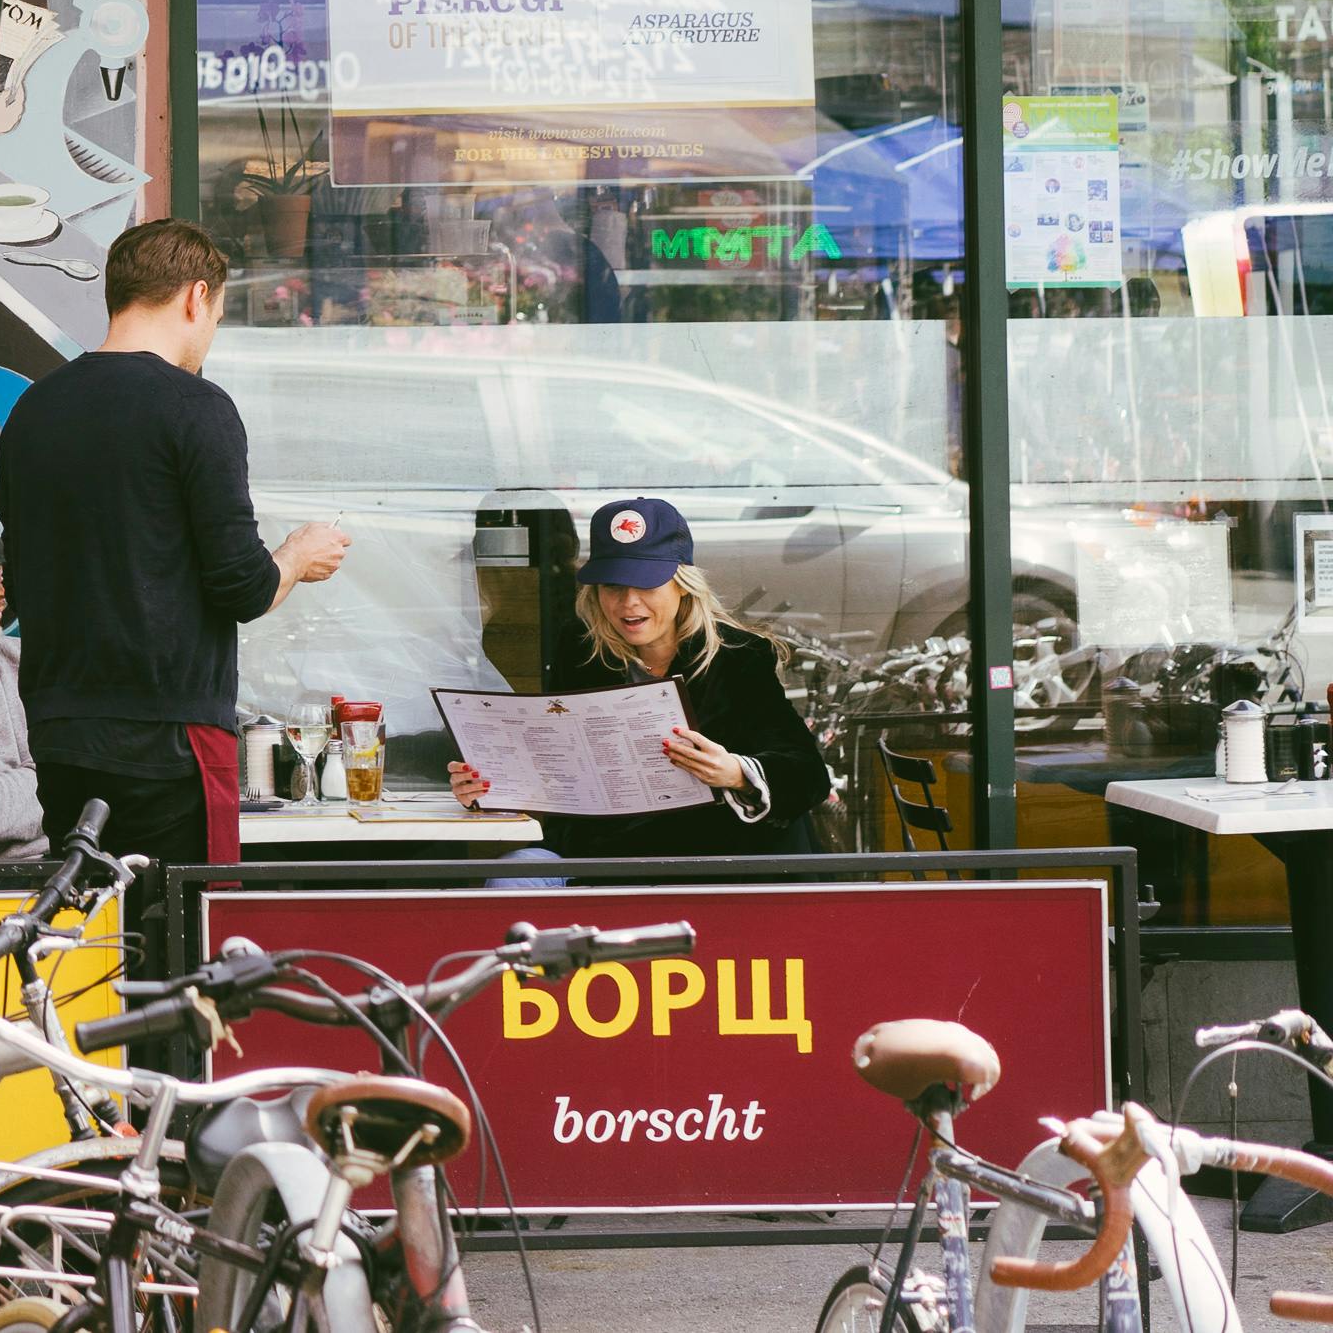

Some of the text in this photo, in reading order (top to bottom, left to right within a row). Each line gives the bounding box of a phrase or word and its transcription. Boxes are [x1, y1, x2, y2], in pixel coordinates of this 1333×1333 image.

[629, 11, 754, 30] ASPARAGUS
[488, 124, 667, 142] visit www.veselka.com
[454, 143, 705, 163] FOR THE LATEST UPDATES
[502, 958, 812, 1054] БОРЩ
[553, 1093, 766, 1144] borscht
